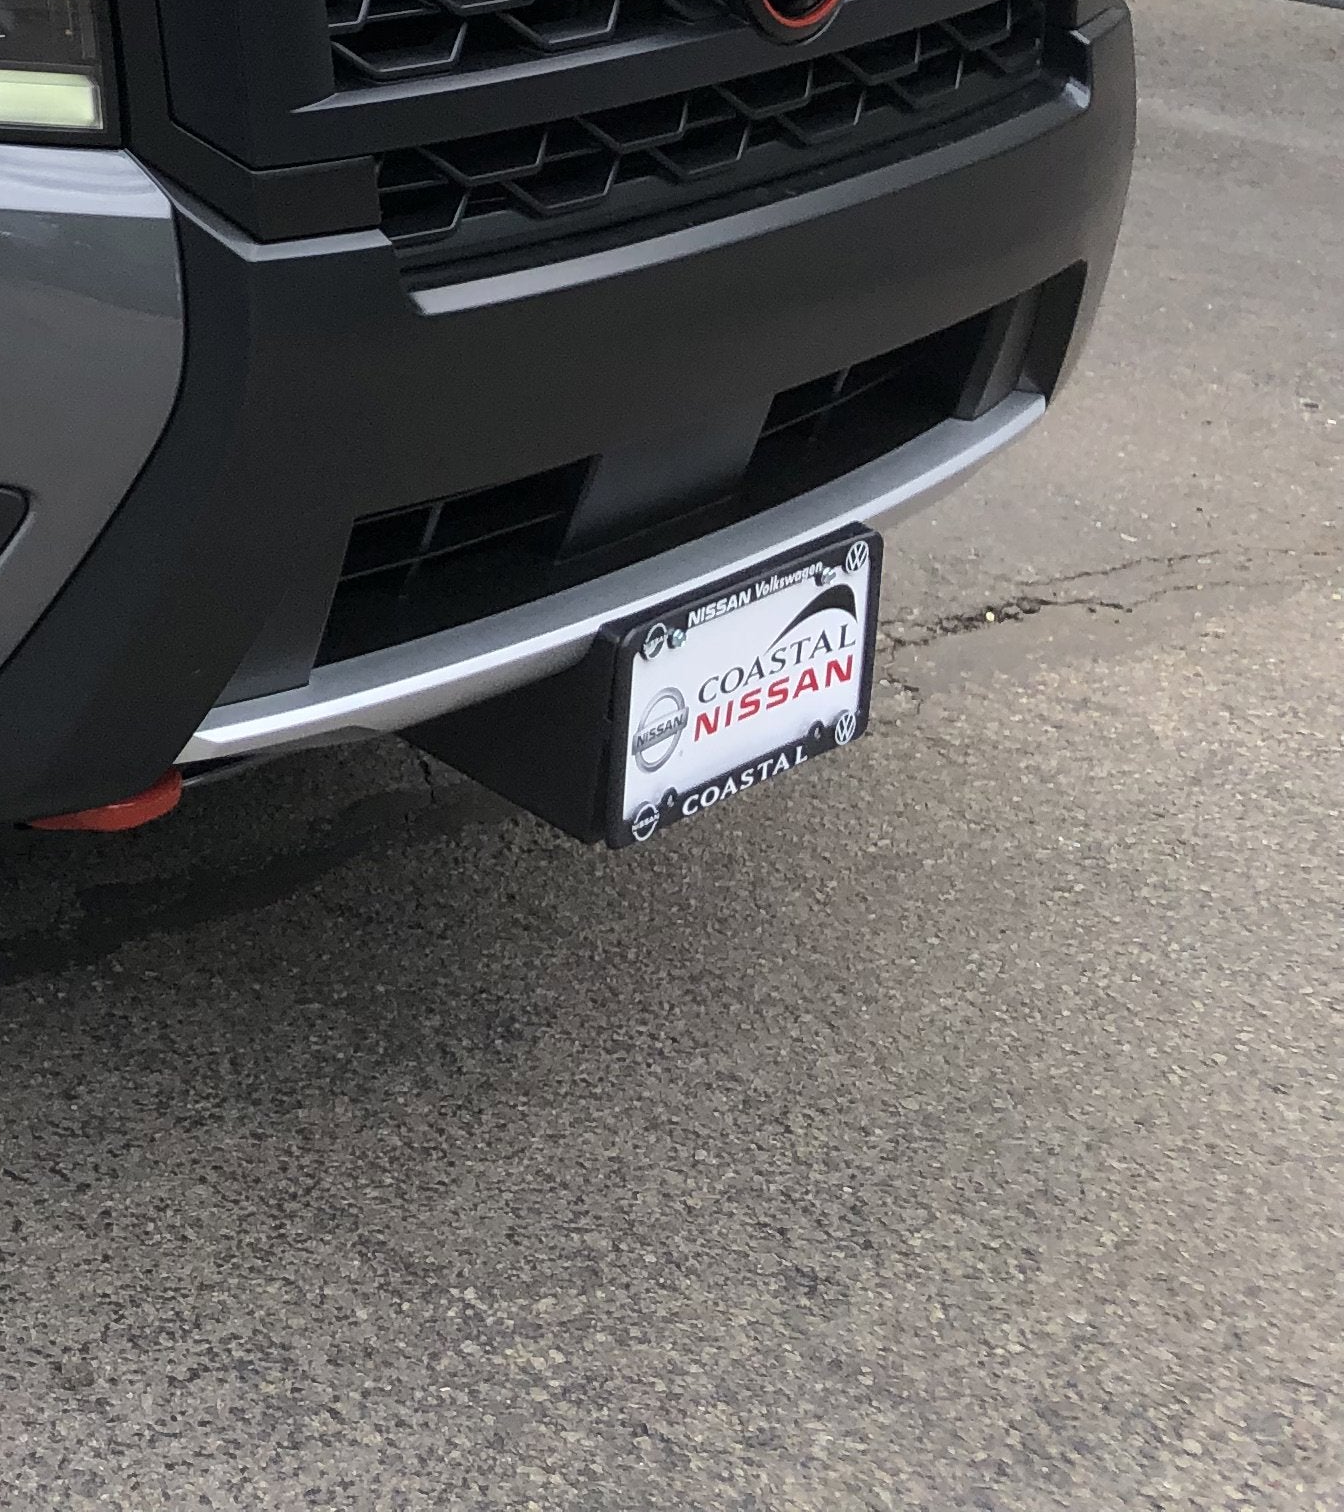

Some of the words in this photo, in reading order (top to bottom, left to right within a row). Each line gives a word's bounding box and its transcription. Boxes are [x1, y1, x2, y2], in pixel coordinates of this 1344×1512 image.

[687, 588, 752, 628] NISSAN
[755, 561, 823, 599] Volkswagen
[693, 654, 853, 741] NISSAN
[698, 624, 858, 704] COASTAL
[636, 714, 684, 748] NISSAN
[682, 745, 808, 817] COASTAL
